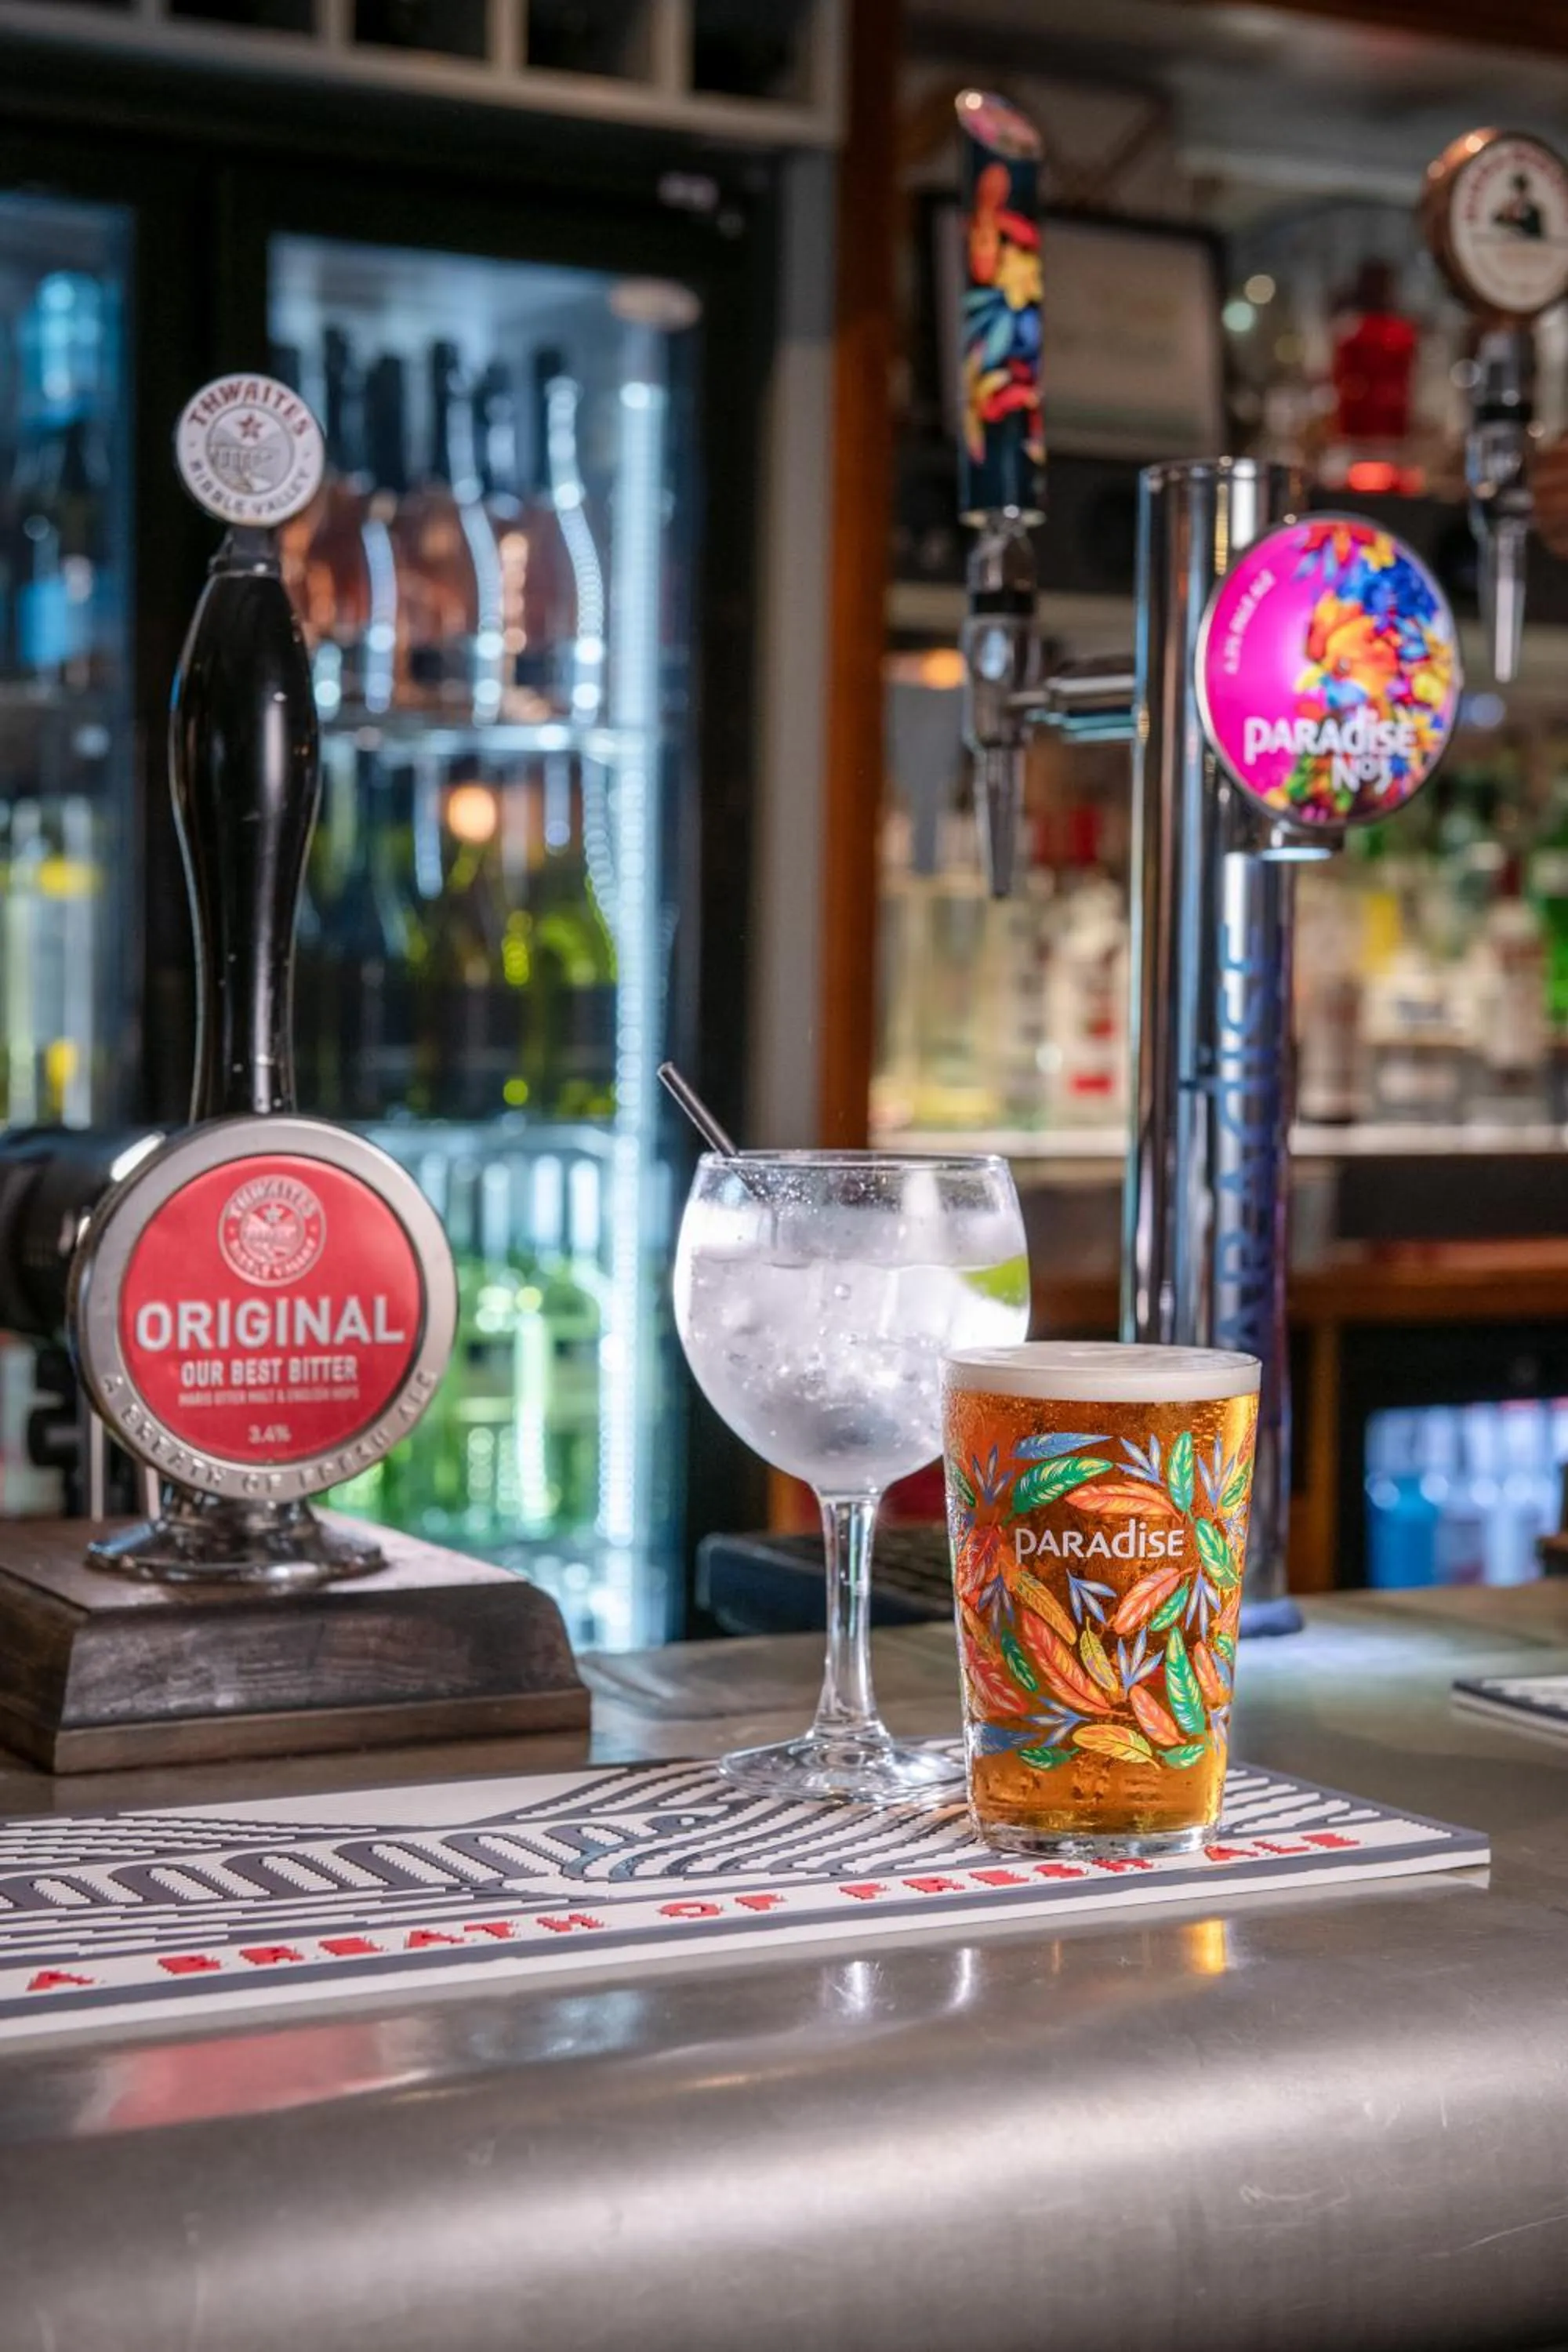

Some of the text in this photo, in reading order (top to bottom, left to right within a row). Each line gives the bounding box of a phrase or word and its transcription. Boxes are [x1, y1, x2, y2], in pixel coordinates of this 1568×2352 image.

[188, 381, 310, 436] THWAITES
[189, 459, 310, 514] RIBBLE VALLEY
[227, 1180, 317, 1218] THWAITES
[136, 1295, 405, 1352] ORIGINAL
[180, 1355, 358, 1388] OUR BEST BITTER
[103, 1371, 437, 1494] A BREATH OF FRESH ALE
[248, 1424, 292, 1444] 3.4%
[26, 1970, 95, 1992] A
[156, 1913, 604, 1976] BREATH
[658, 1893, 786, 1918] OF
[1203, 1832, 1360, 1861] ALE
